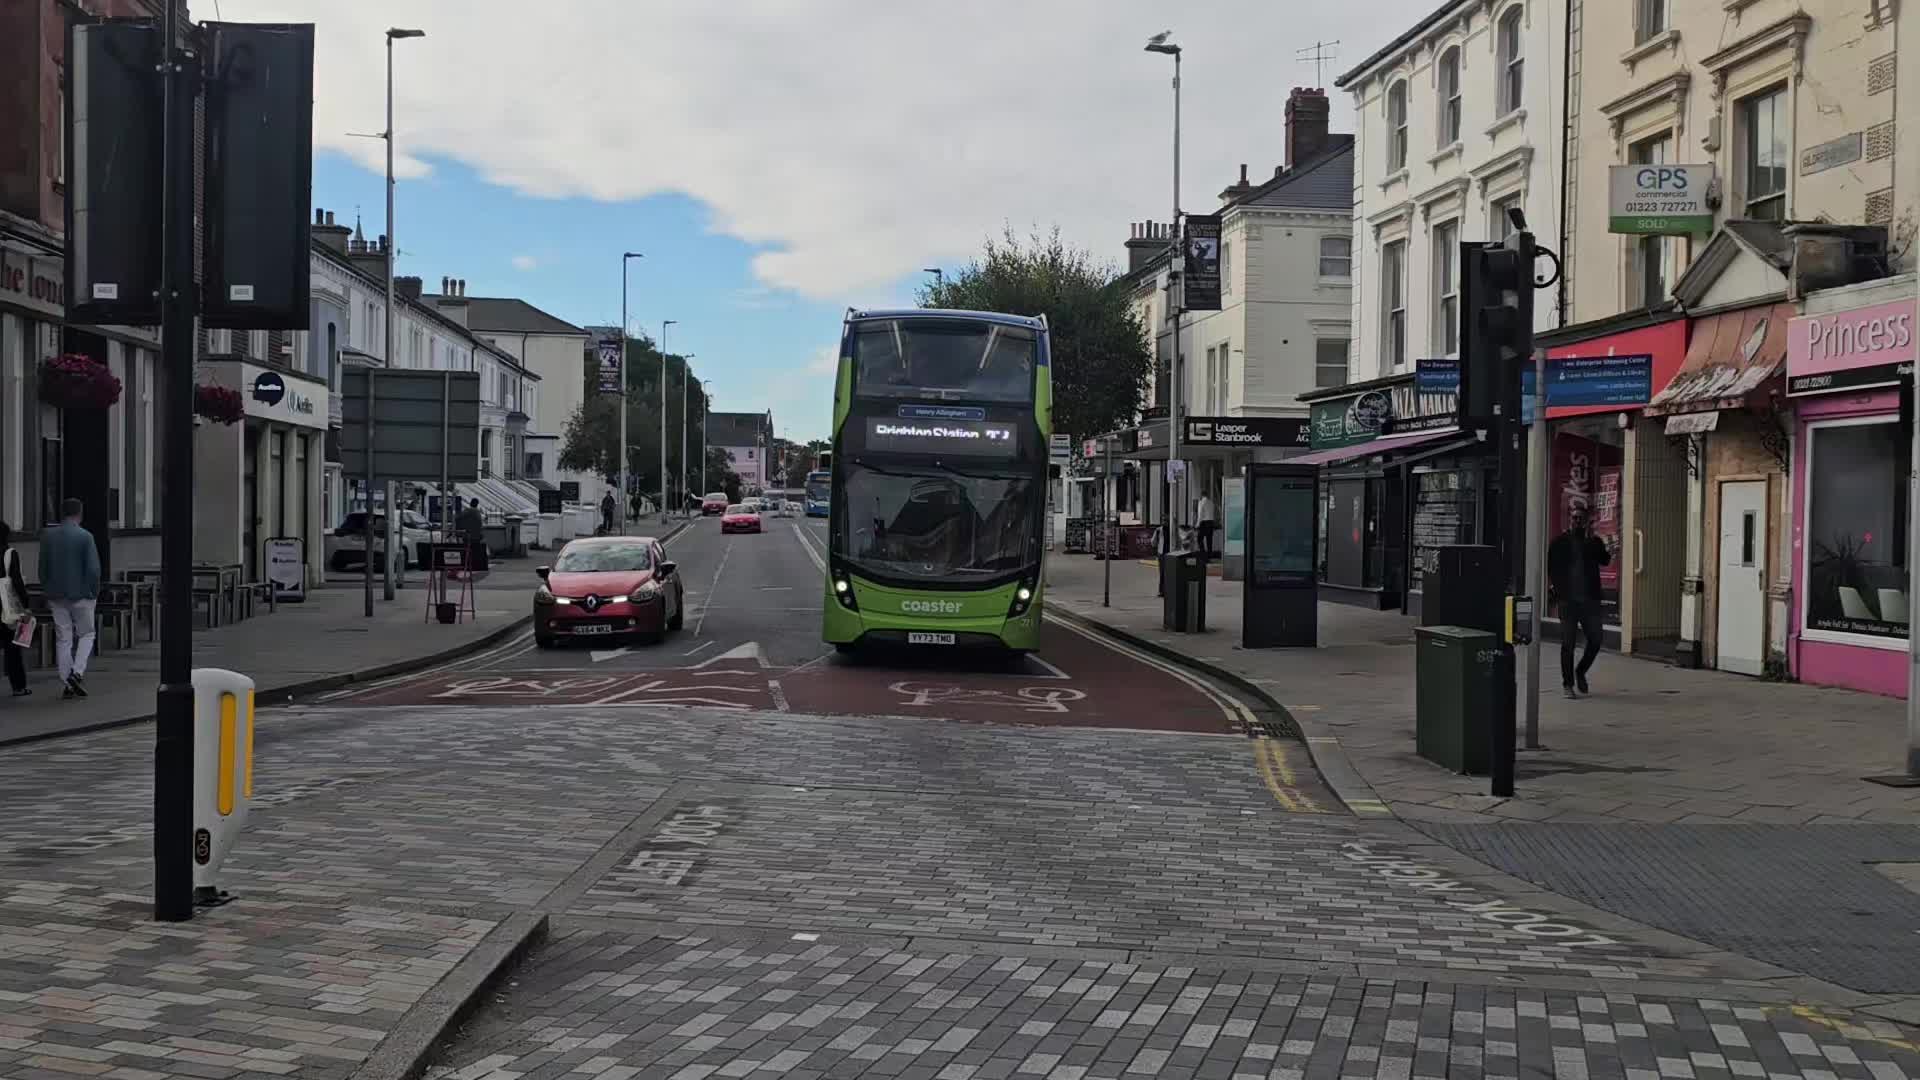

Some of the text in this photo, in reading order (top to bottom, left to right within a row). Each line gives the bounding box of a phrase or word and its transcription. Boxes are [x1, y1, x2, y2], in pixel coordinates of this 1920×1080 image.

[1637, 168, 1687, 189] GPS
[1625, 200, 1697, 213] 01323 727271
[1638, 218, 1667, 229] SOLD
[1808, 314, 1911, 361] Princess
[1216, 423, 1247, 433] Leaper
[1216, 432, 1263, 442] Stanbrook
[902, 600, 962, 612] coaster
[1445, 899, 1618, 947] LOOK
